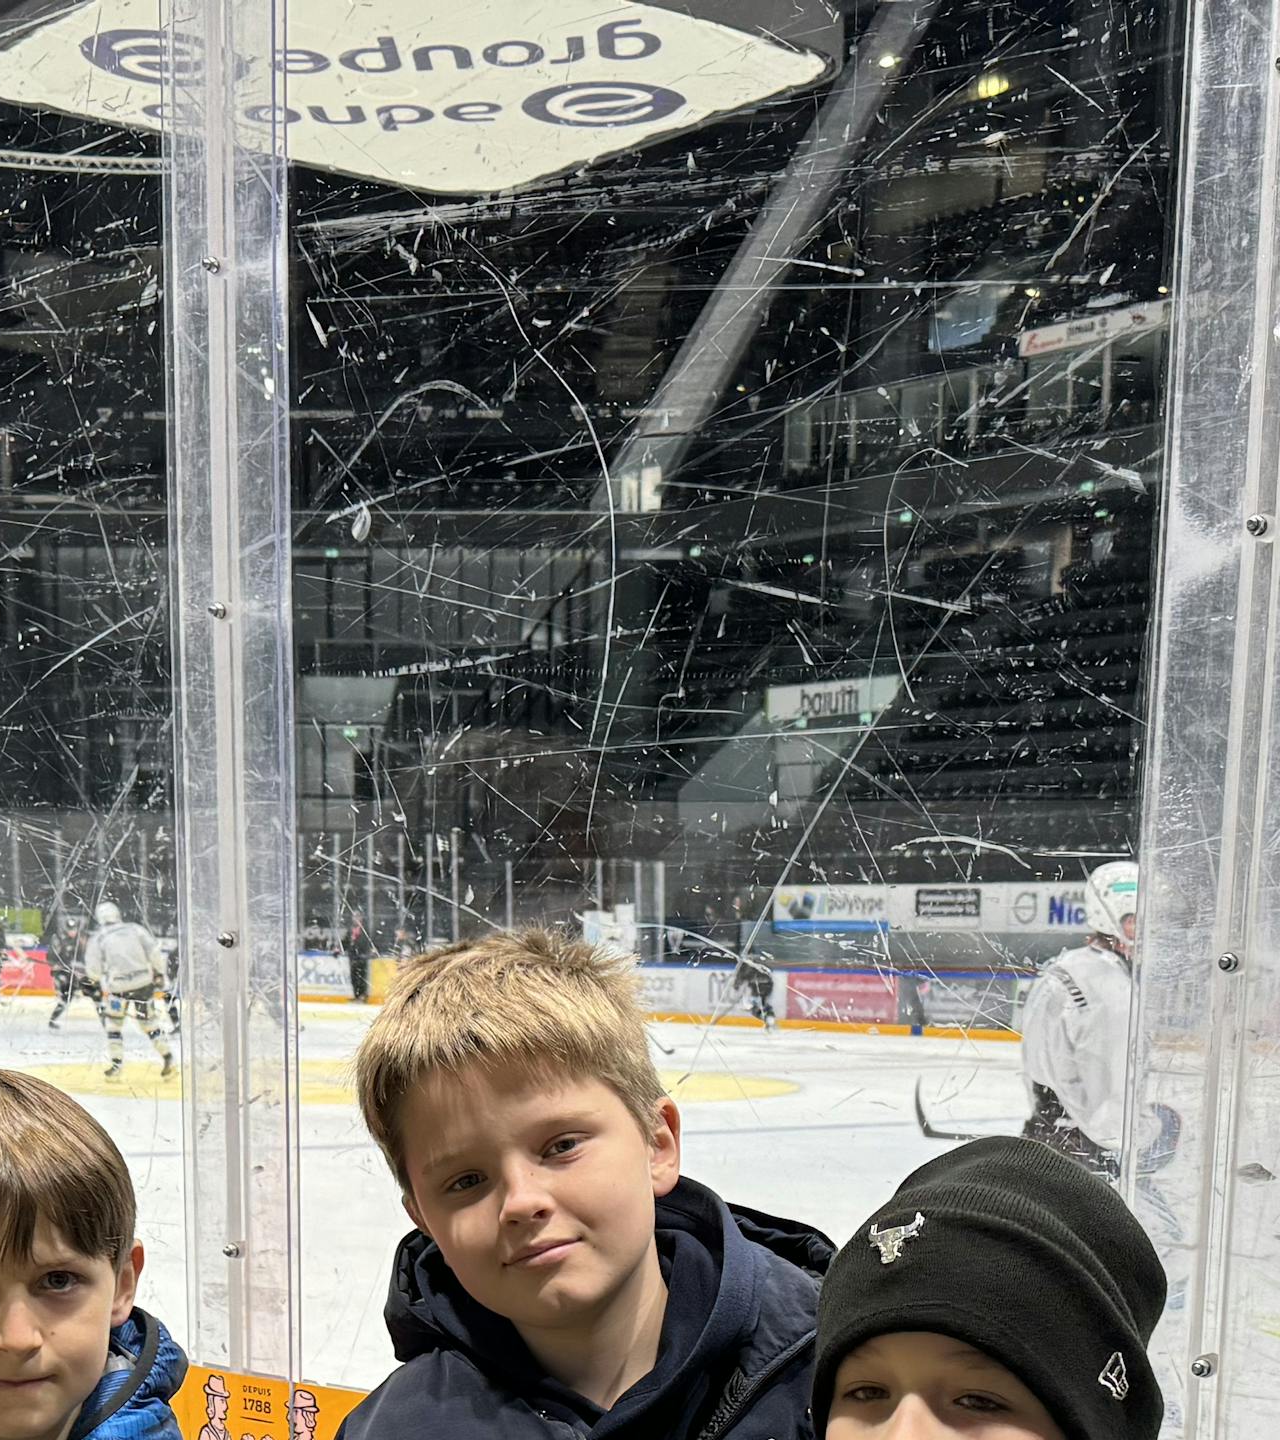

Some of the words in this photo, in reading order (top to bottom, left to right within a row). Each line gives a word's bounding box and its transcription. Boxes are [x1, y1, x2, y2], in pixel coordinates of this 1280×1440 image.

[142, 102, 502, 132] goupe
[242, 1384, 272, 1397] DEPUIS
[242, 1398, 272, 1415] 1788
